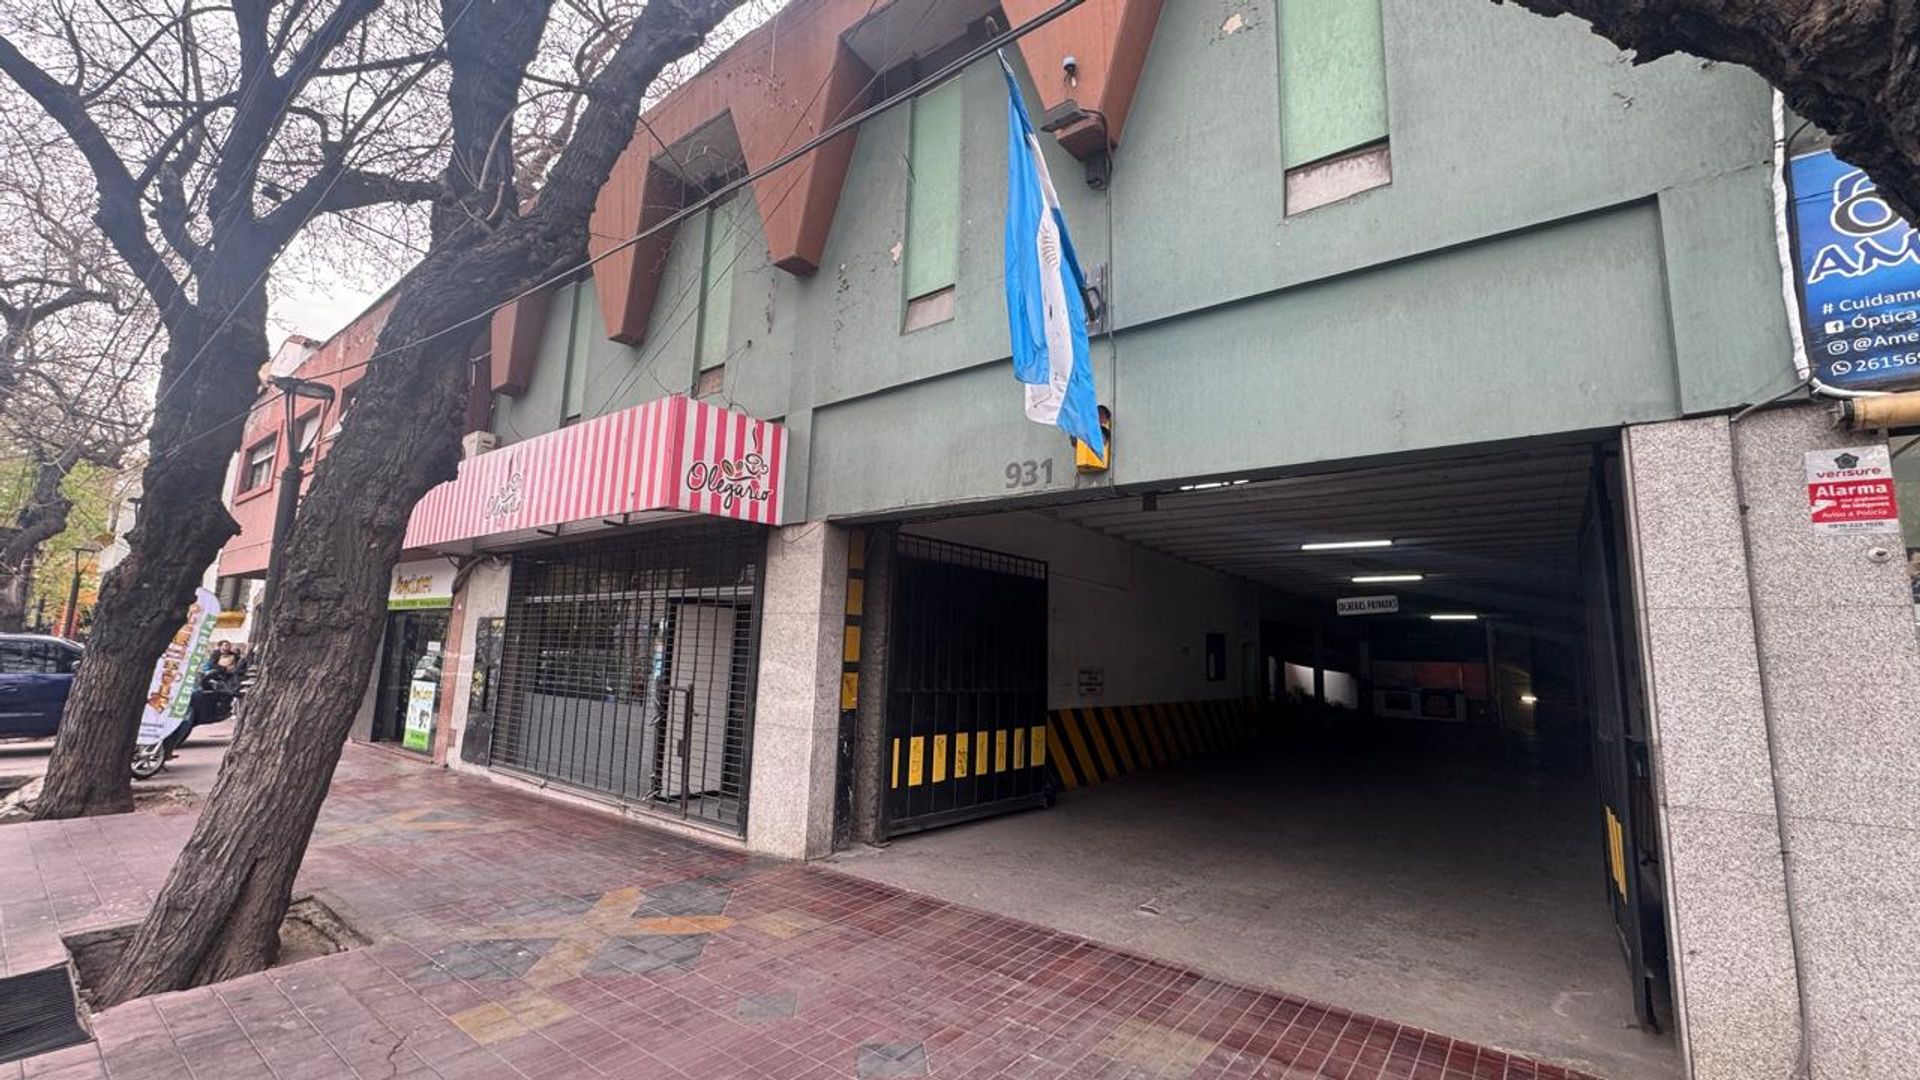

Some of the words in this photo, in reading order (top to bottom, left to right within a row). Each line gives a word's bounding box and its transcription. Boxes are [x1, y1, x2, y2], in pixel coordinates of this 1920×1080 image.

[1839, 289, 1920, 312] Cuidam
[1851, 310, 1917, 329] Óptica
[1855, 352, 1920, 372] 26156
[1005, 458, 1053, 489] 931
[1816, 467, 1881, 478] verisure
[686, 462, 771, 510] Olegario
[1816, 483, 1887, 498] Alarma
